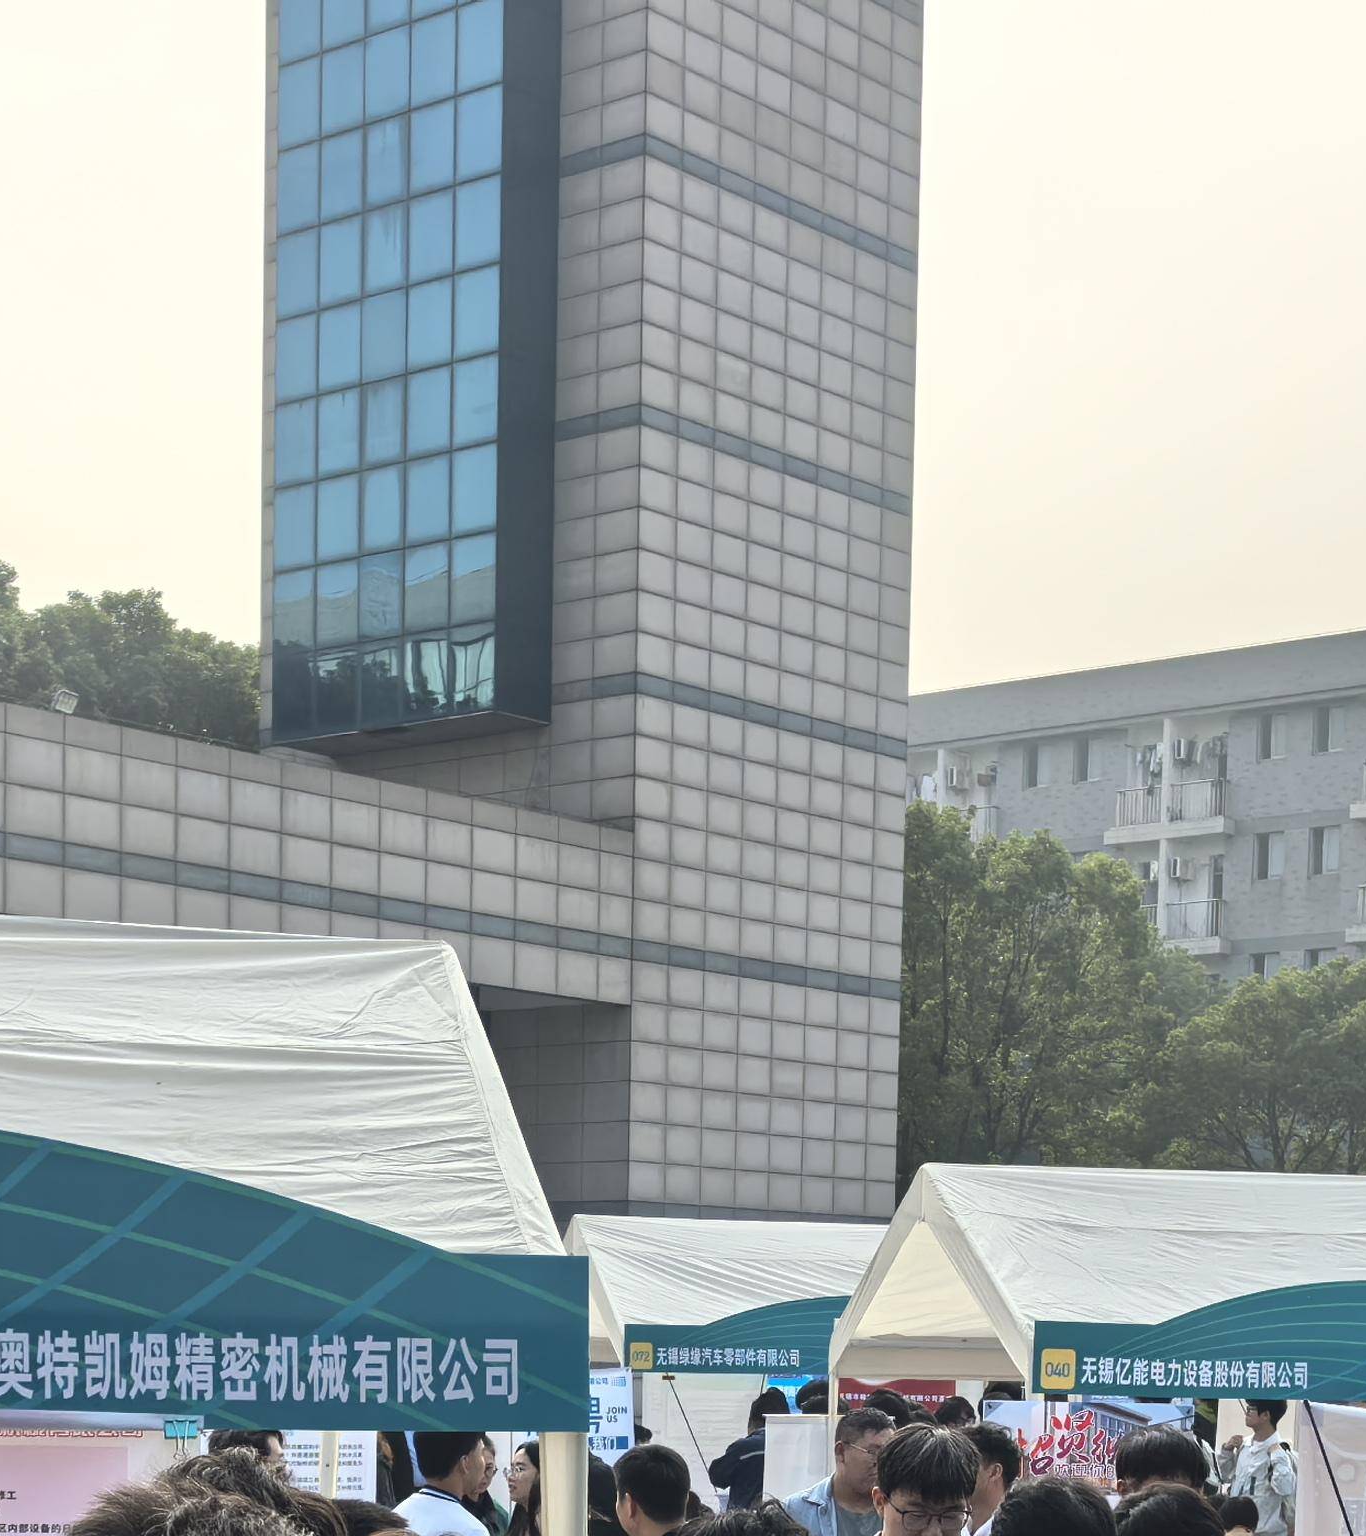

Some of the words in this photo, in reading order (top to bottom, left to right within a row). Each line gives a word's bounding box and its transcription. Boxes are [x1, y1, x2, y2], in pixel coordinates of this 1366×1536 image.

[1045, 1361, 1070, 1378] 040
[1080, 1357, 1309, 1390] 无锡亿能电力设备股份有限公司
[606, 1406, 628, 1415] JOIN
[606, 1415, 618, 1423] US
